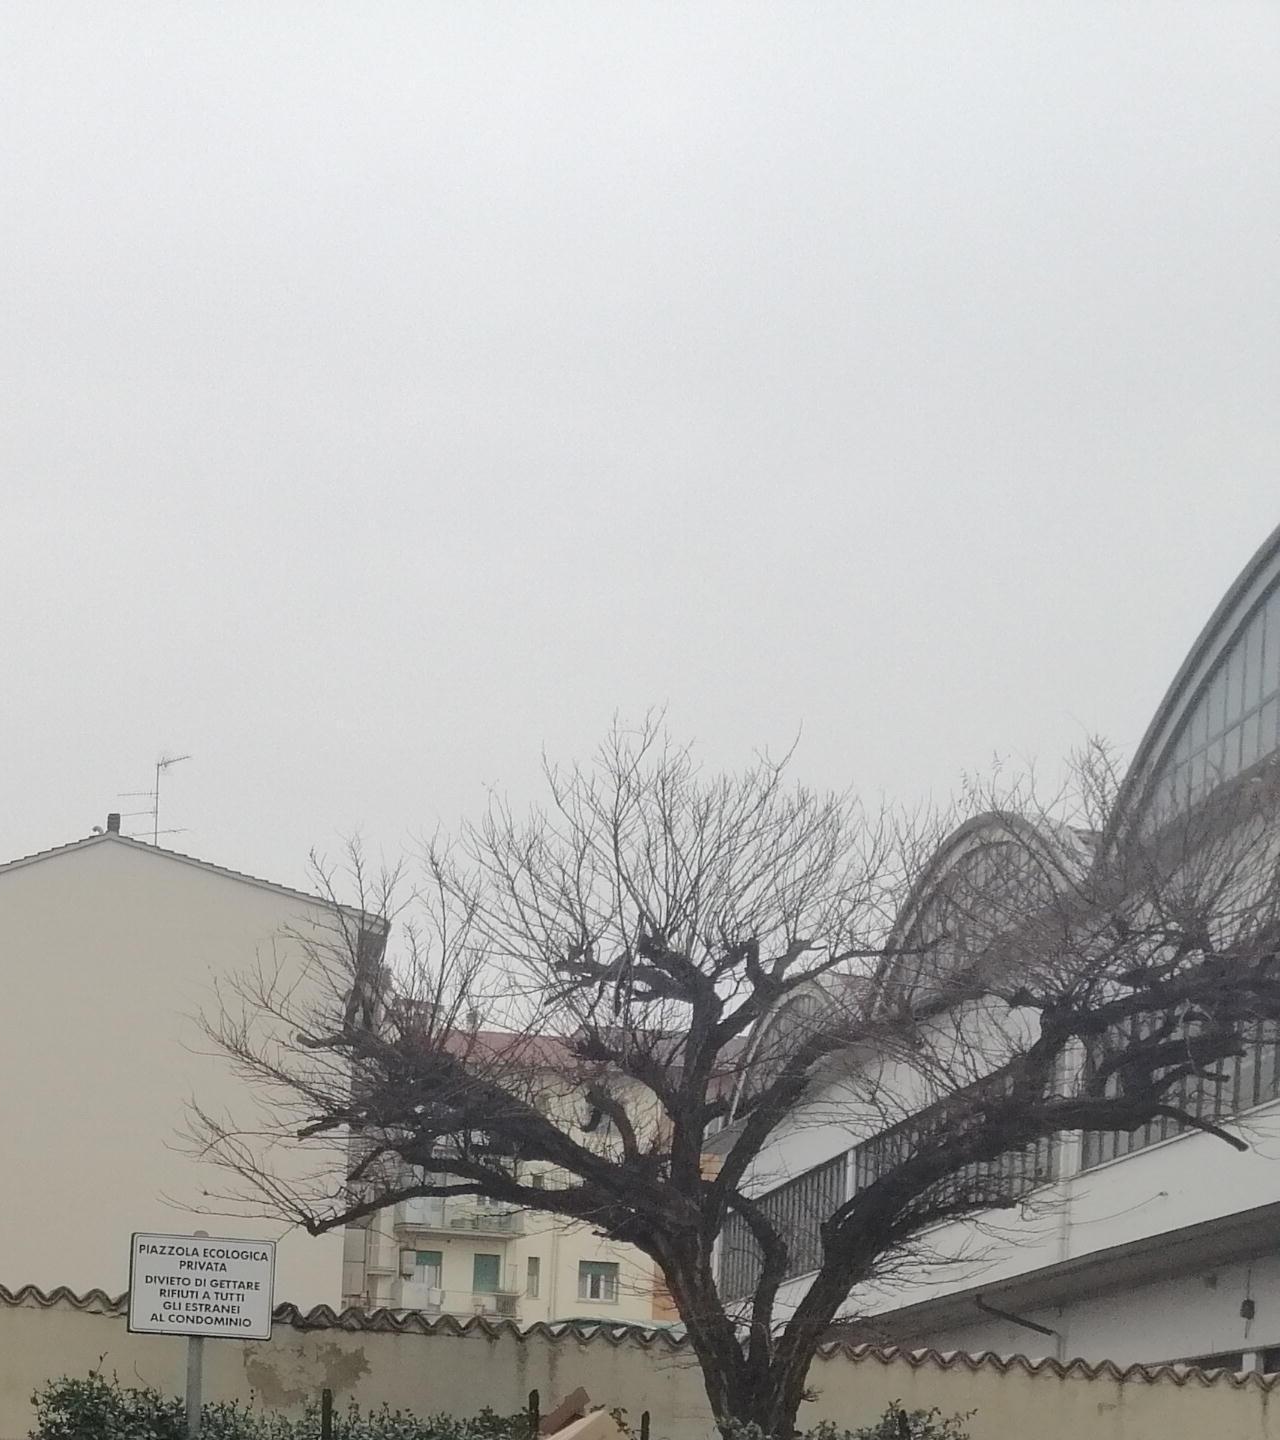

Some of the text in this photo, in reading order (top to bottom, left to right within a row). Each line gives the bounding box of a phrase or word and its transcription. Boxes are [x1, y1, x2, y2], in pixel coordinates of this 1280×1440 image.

[138, 1244, 269, 1262] PIAZZOLA ECOLOGICA
[179, 1260, 227, 1273] PRIVATA
[145, 1275, 261, 1291] DIVIETO DI GETTARE
[159, 1288, 245, 1302] RIFIUTI A TUTTI
[163, 1301, 240, 1314] GLI ESTRANEI
[150, 1313, 252, 1328] AL CONDOMINIO
